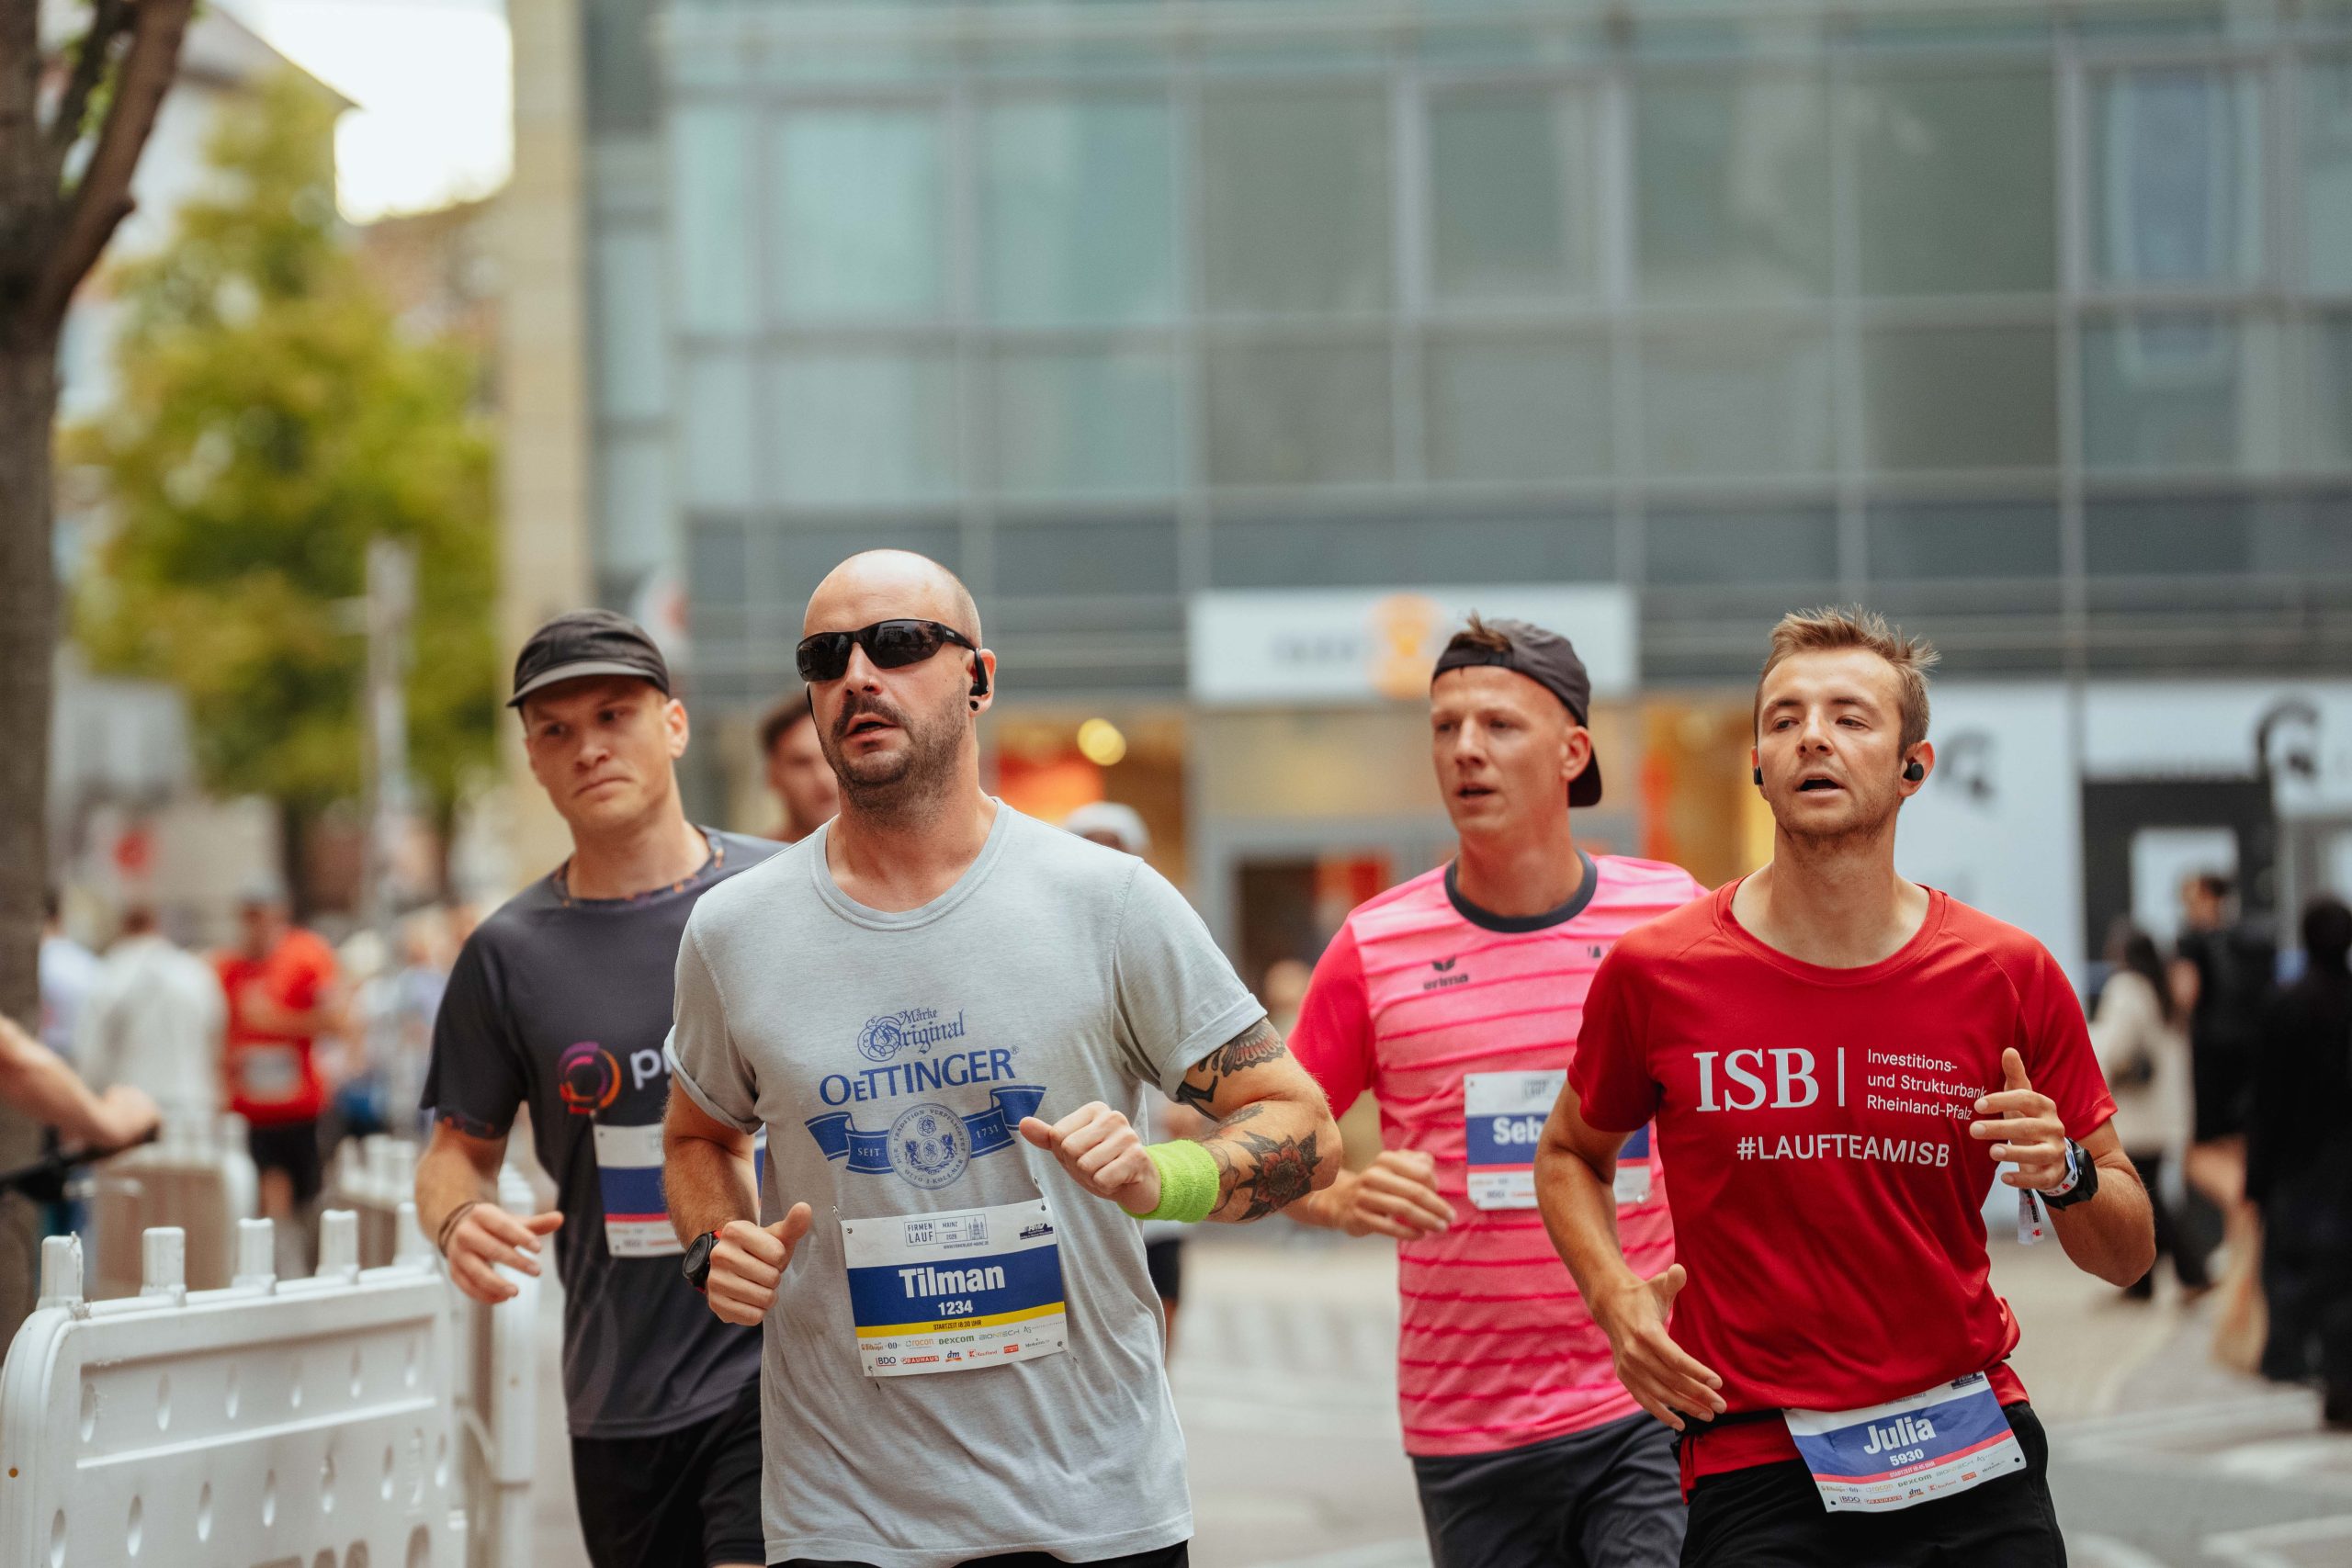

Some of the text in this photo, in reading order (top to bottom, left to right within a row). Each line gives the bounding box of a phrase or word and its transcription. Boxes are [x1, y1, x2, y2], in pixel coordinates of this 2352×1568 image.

[857, 1009, 966, 1062] Original
[1868, 1048, 1958, 1073] Investitions-
[1692, 1046, 1819, 1112] ISB
[1868, 1074, 1987, 1100] und Strukturbank
[1867, 1094, 1973, 1121] Rheinland-Pfalz
[976, 1124, 999, 1140] 1731
[857, 1147, 879, 1157] SEIT
[1736, 1134, 1950, 1168] #LAUFTEAMISB
[907, 1223, 933, 1232] FIRMEN
[908, 1231, 933, 1243] LAUF
[899, 1265, 1006, 1299] Tilman
[938, 1300, 973, 1316] 1234
[877, 1357, 897, 1365] BDO
[907, 1355, 938, 1364] BAUHAUS
[946, 1350, 960, 1359] dm
[1863, 1416, 1937, 1455] Julia
[1889, 1448, 1925, 1467] 5930
